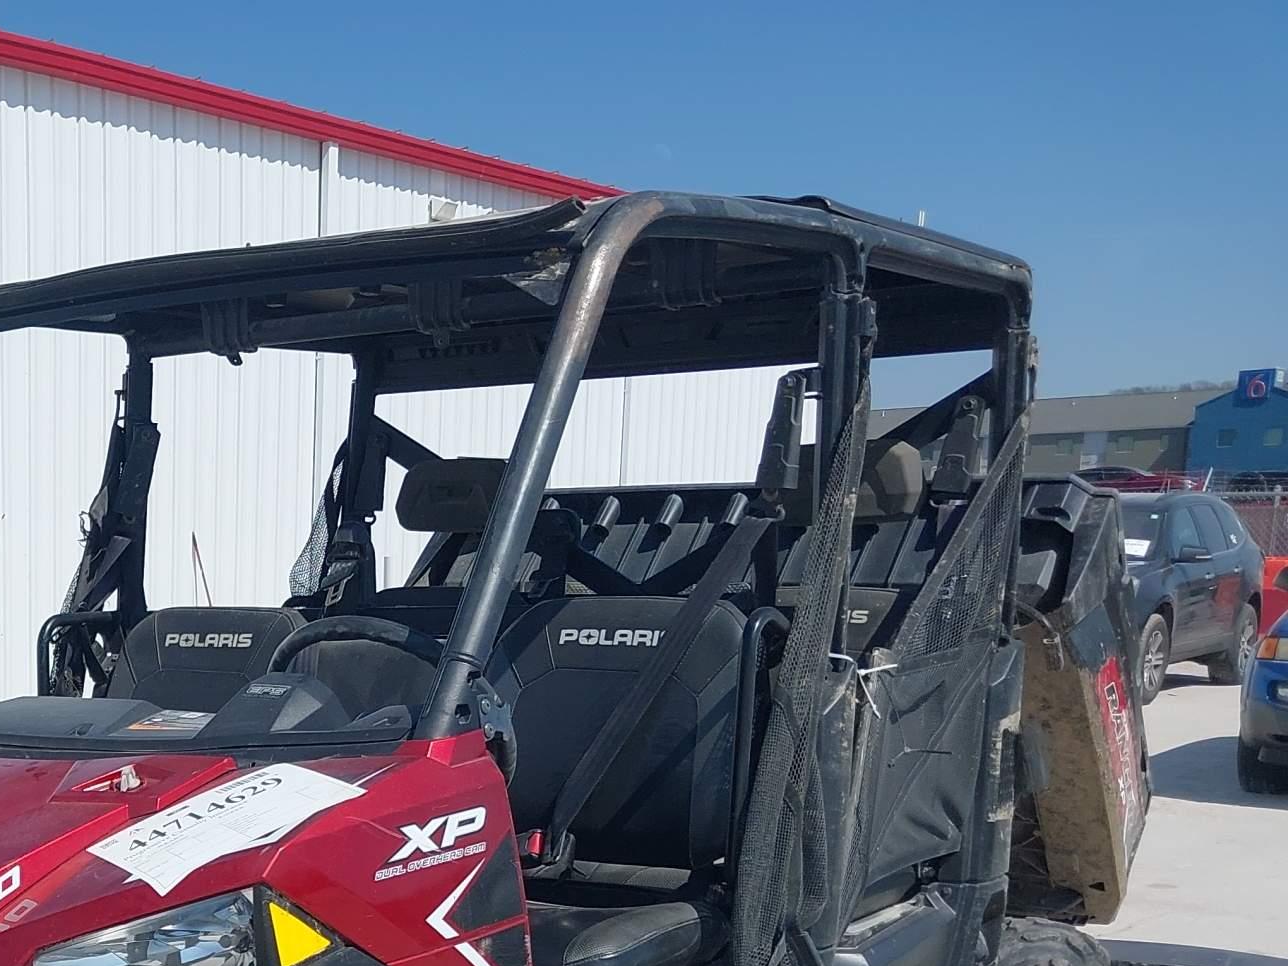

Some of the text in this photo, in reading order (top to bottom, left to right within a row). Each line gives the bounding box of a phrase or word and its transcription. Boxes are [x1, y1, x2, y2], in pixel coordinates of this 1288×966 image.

[1247, 375, 1266, 400] 6
[165, 633, 253, 648] POLARIS
[559, 629, 665, 647] POLARI
[128, 777, 283, 852] 44714629
[387, 806, 487, 863] XP
